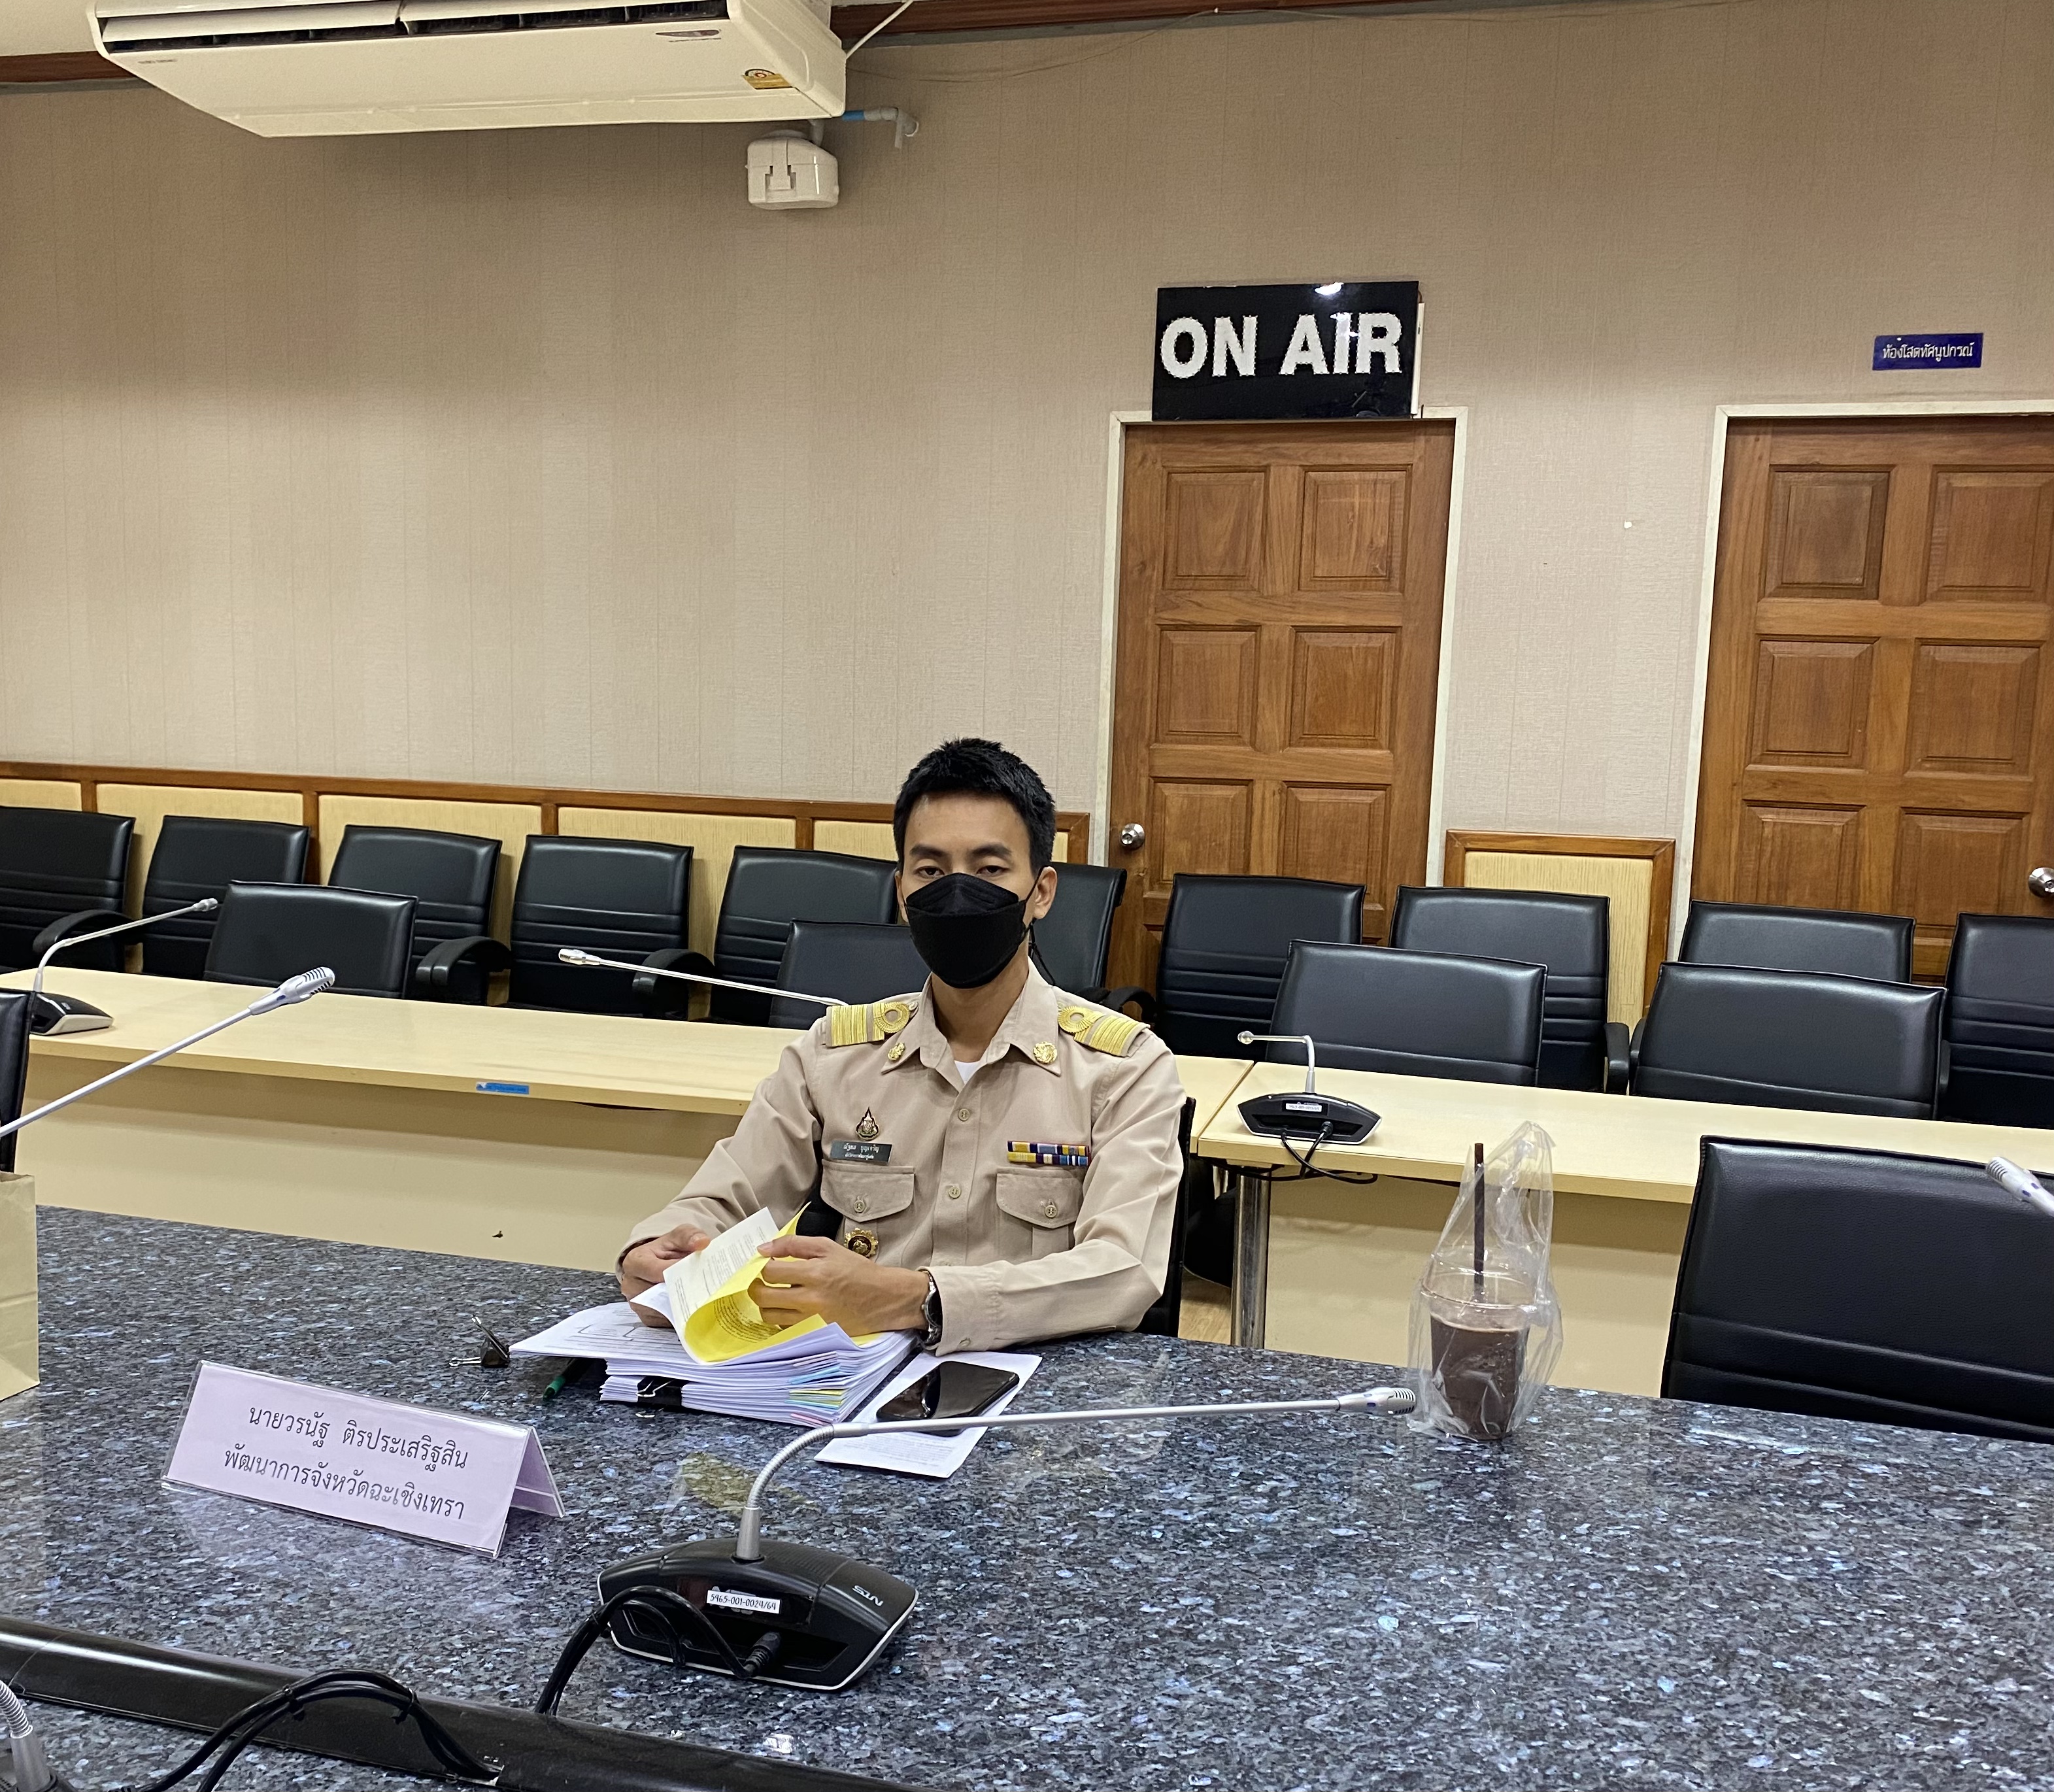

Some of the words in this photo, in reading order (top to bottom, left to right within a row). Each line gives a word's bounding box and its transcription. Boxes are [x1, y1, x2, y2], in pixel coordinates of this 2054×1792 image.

[1160, 315, 1258, 379] ON
[1279, 312, 1402, 375] AIR
[249, 1407, 330, 1447] นายวรนัฐ
[342, 1420, 469, 1472] ติรประเสริฐสิน
[224, 1443, 465, 1520] พัฒนาการจังหวัดฉะเชิงเทรา
[710, 1593, 776, 1610] 5965-001-0024/64
